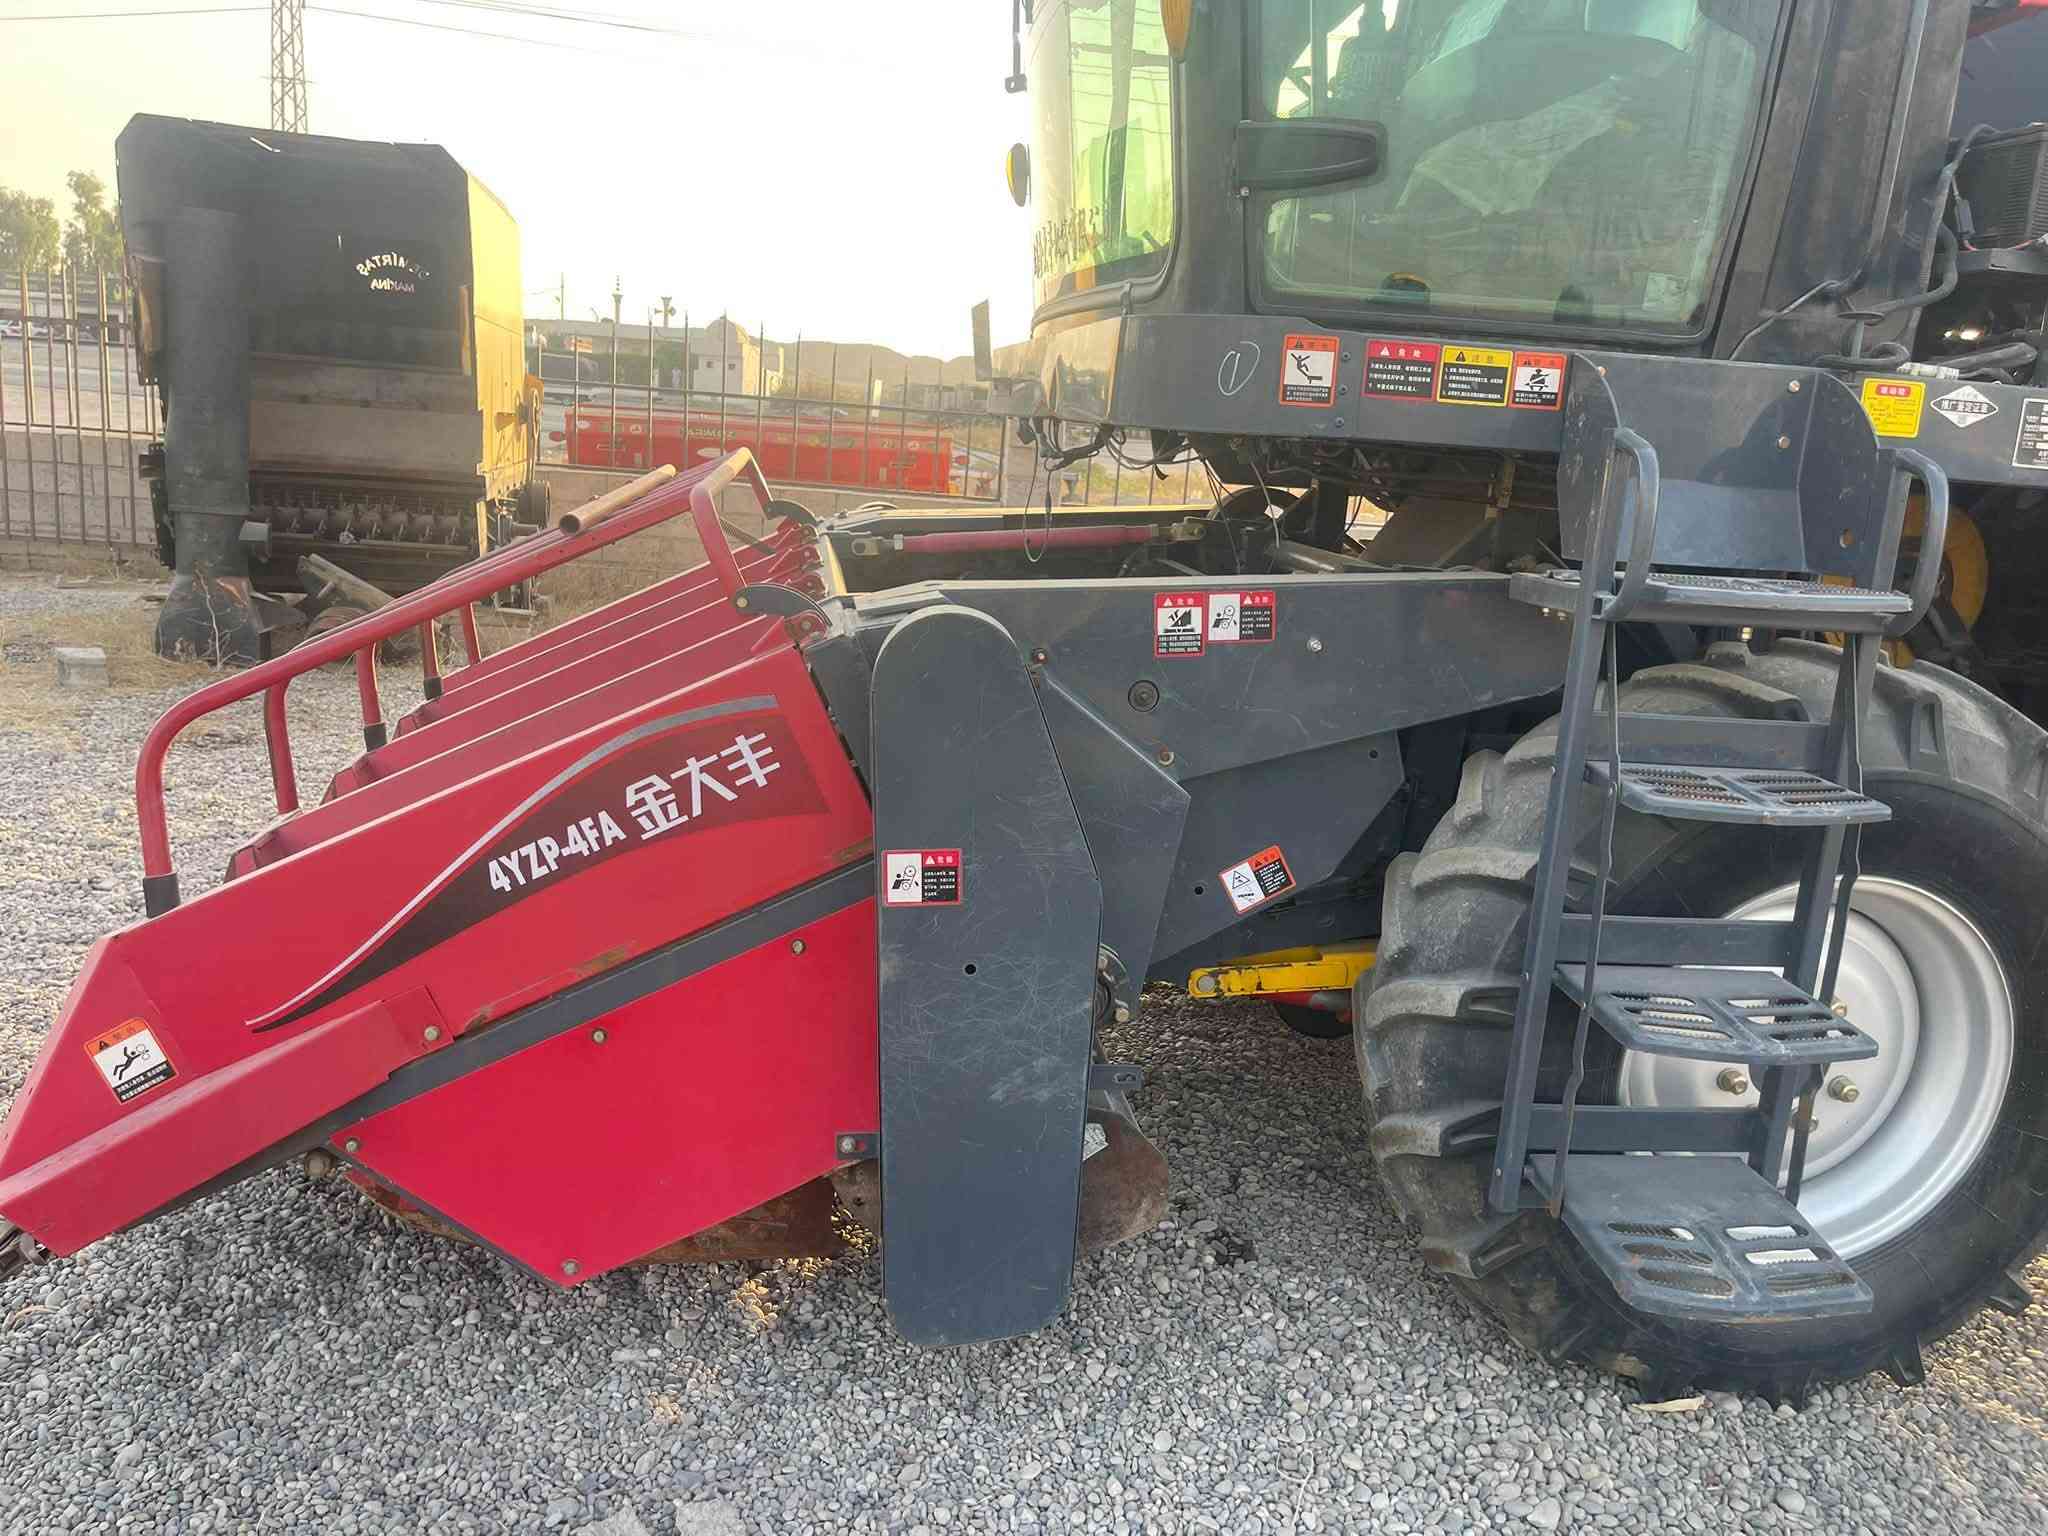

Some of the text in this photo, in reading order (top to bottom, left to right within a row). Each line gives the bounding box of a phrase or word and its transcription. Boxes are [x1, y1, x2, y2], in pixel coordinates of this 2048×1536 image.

[488, 732, 781, 892] 4YZP-4FA 金大丰
